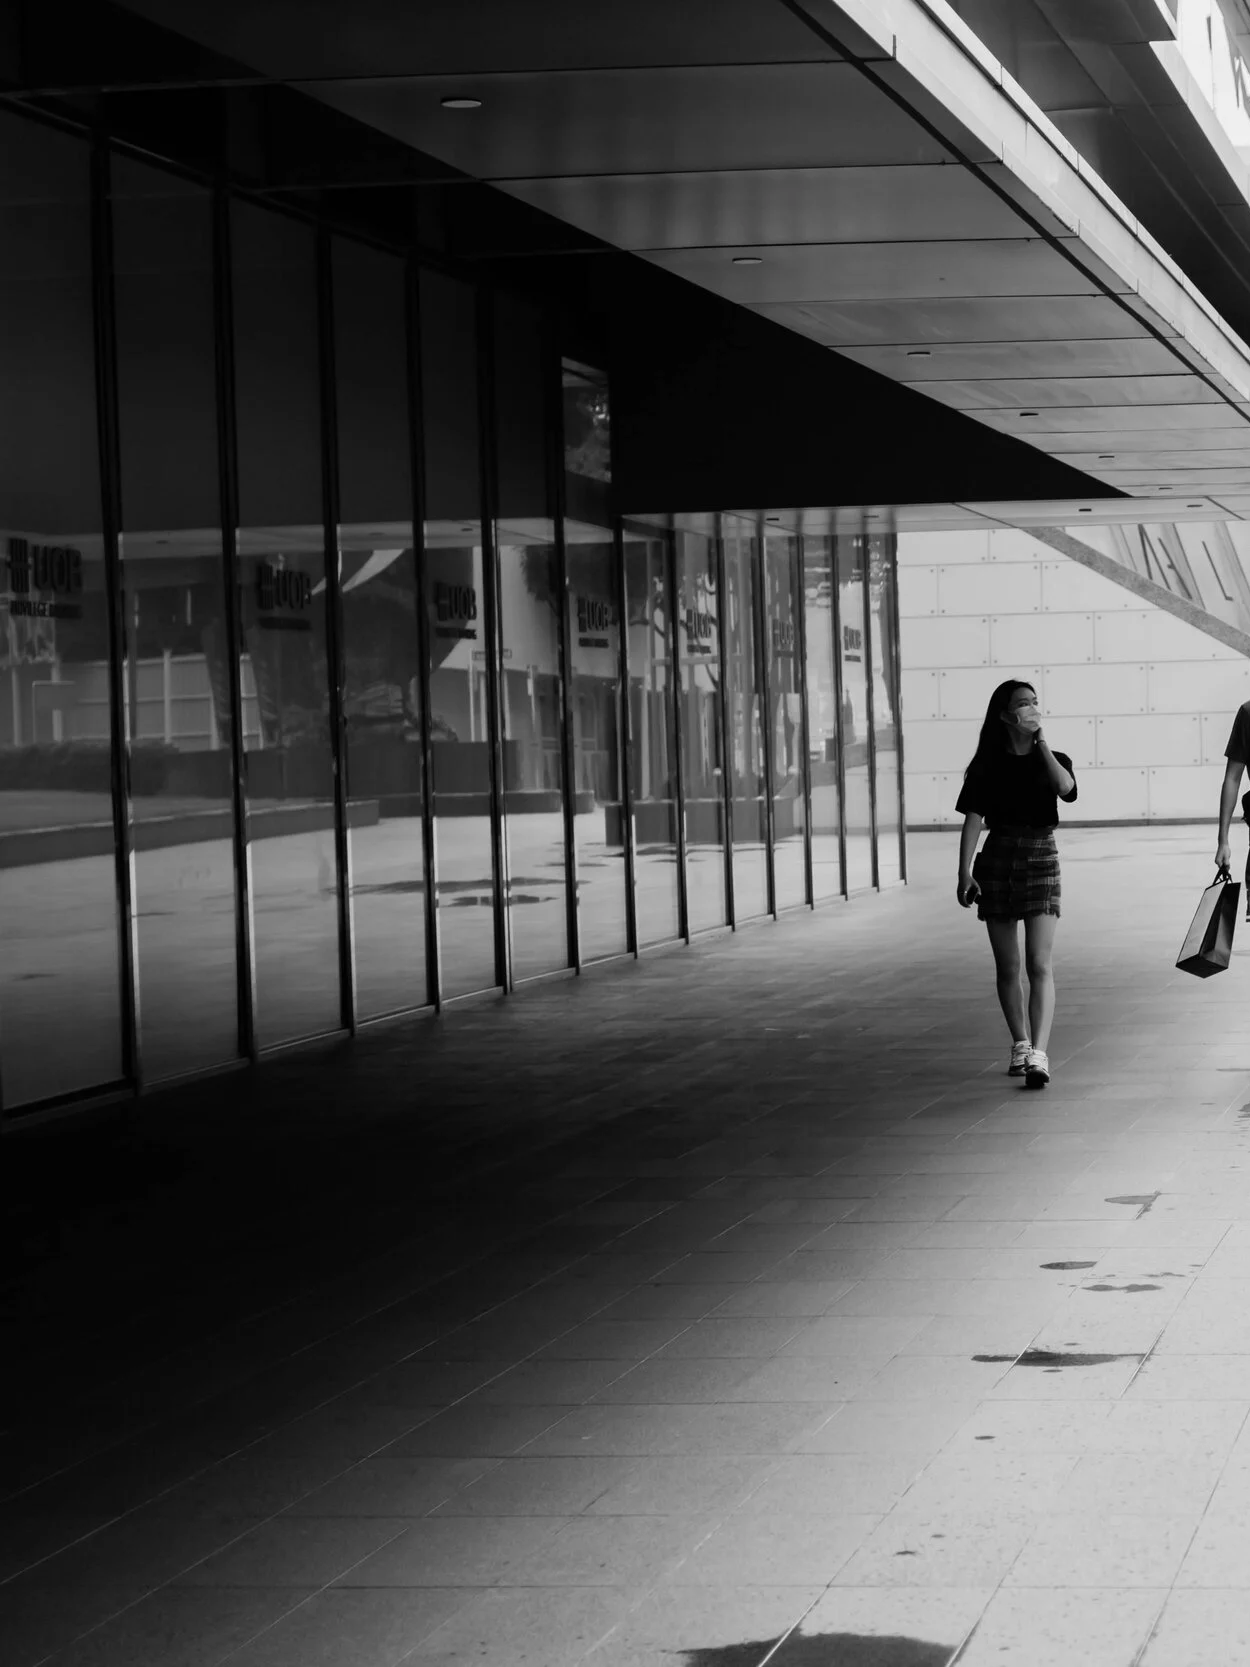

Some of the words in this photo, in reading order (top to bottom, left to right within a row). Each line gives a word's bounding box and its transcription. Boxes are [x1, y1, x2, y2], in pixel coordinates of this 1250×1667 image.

[33, 546, 82, 594] UOB
[276, 571, 311, 611] UOB
[448, 586, 477, 620] UOB
[586, 600, 611, 631] UOB
